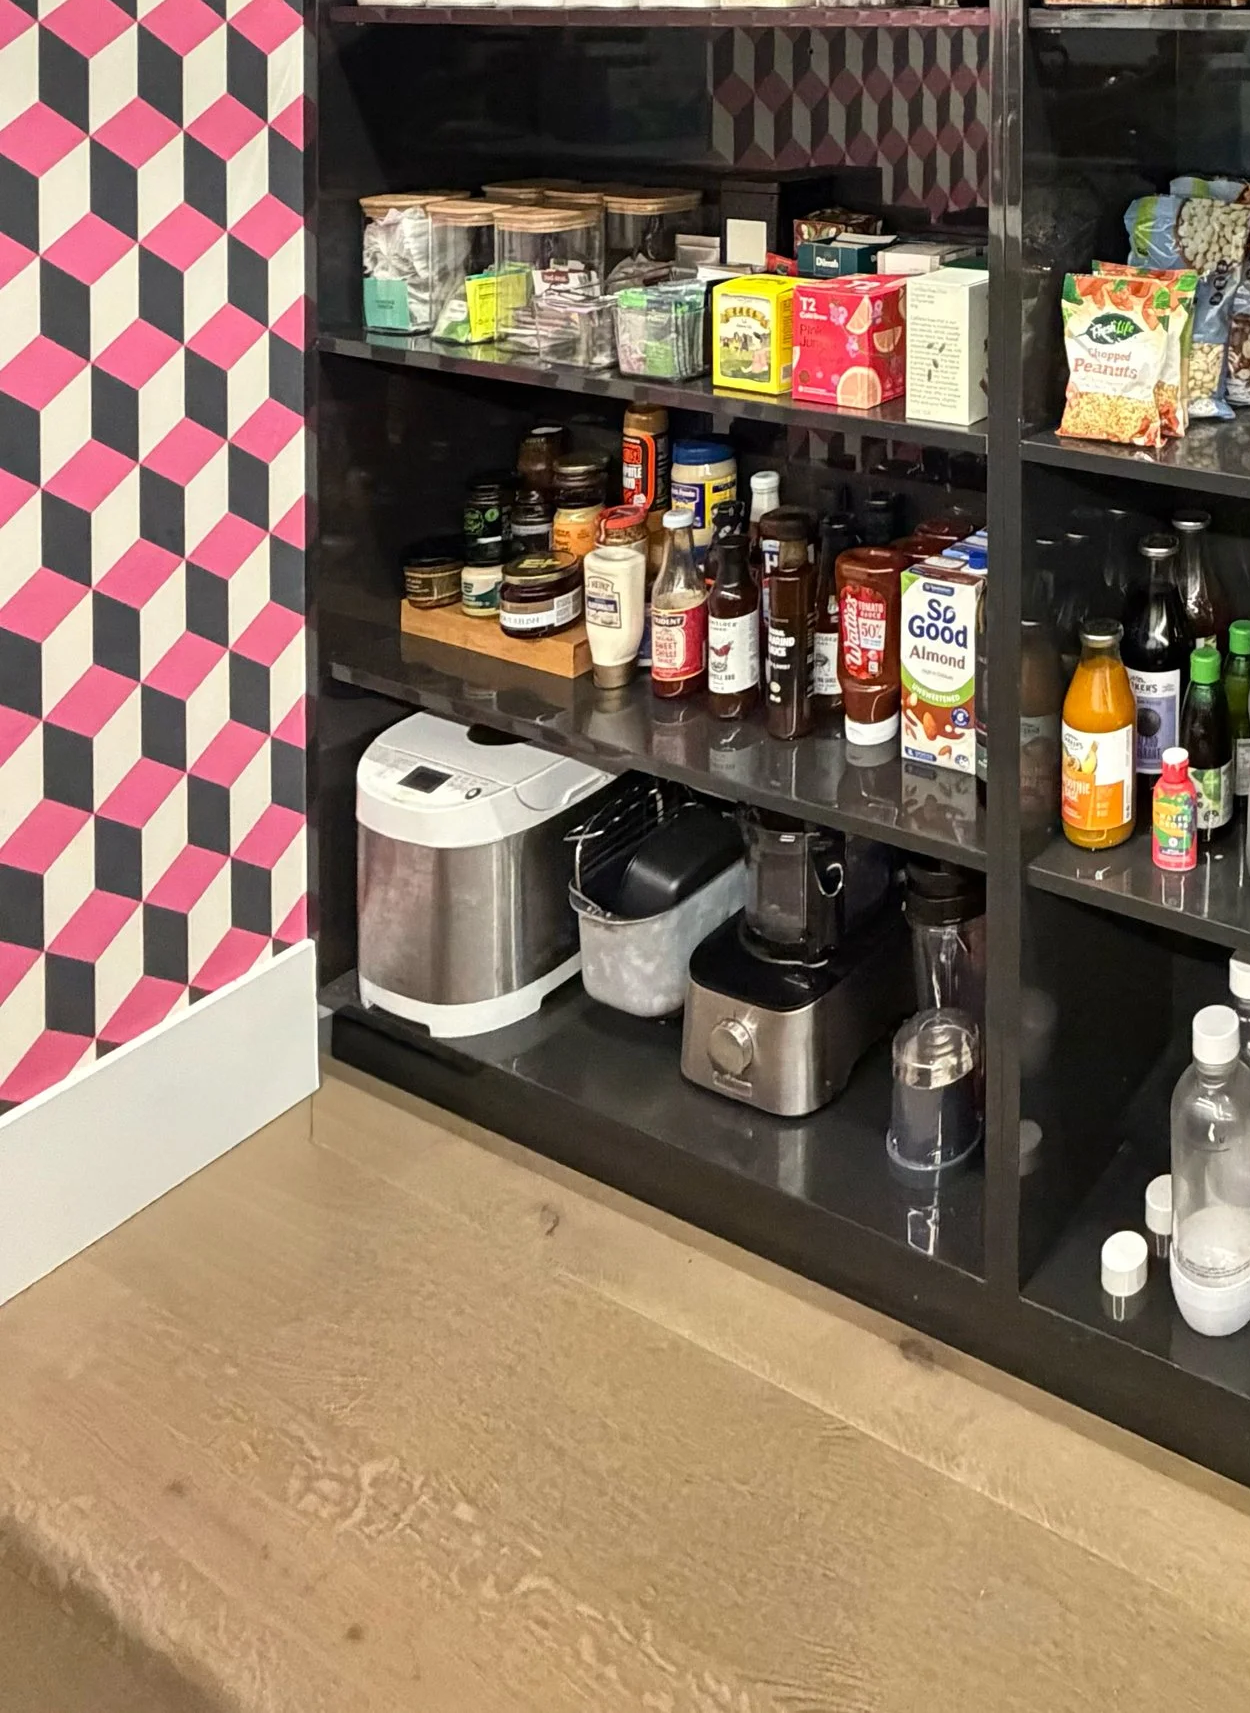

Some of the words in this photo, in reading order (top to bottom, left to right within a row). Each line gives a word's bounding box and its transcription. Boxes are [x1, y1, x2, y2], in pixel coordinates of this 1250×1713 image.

[799, 296, 817, 312] T2
[1088, 347, 1132, 363] Chopped
[1073, 358, 1138, 380] Peanuts
[858, 600, 885, 614] TOMATO
[927, 598, 957, 625] So
[908, 614, 968, 650] Good
[909, 644, 966, 671] Almond
[911, 683, 961, 703] UNSWEETENED
